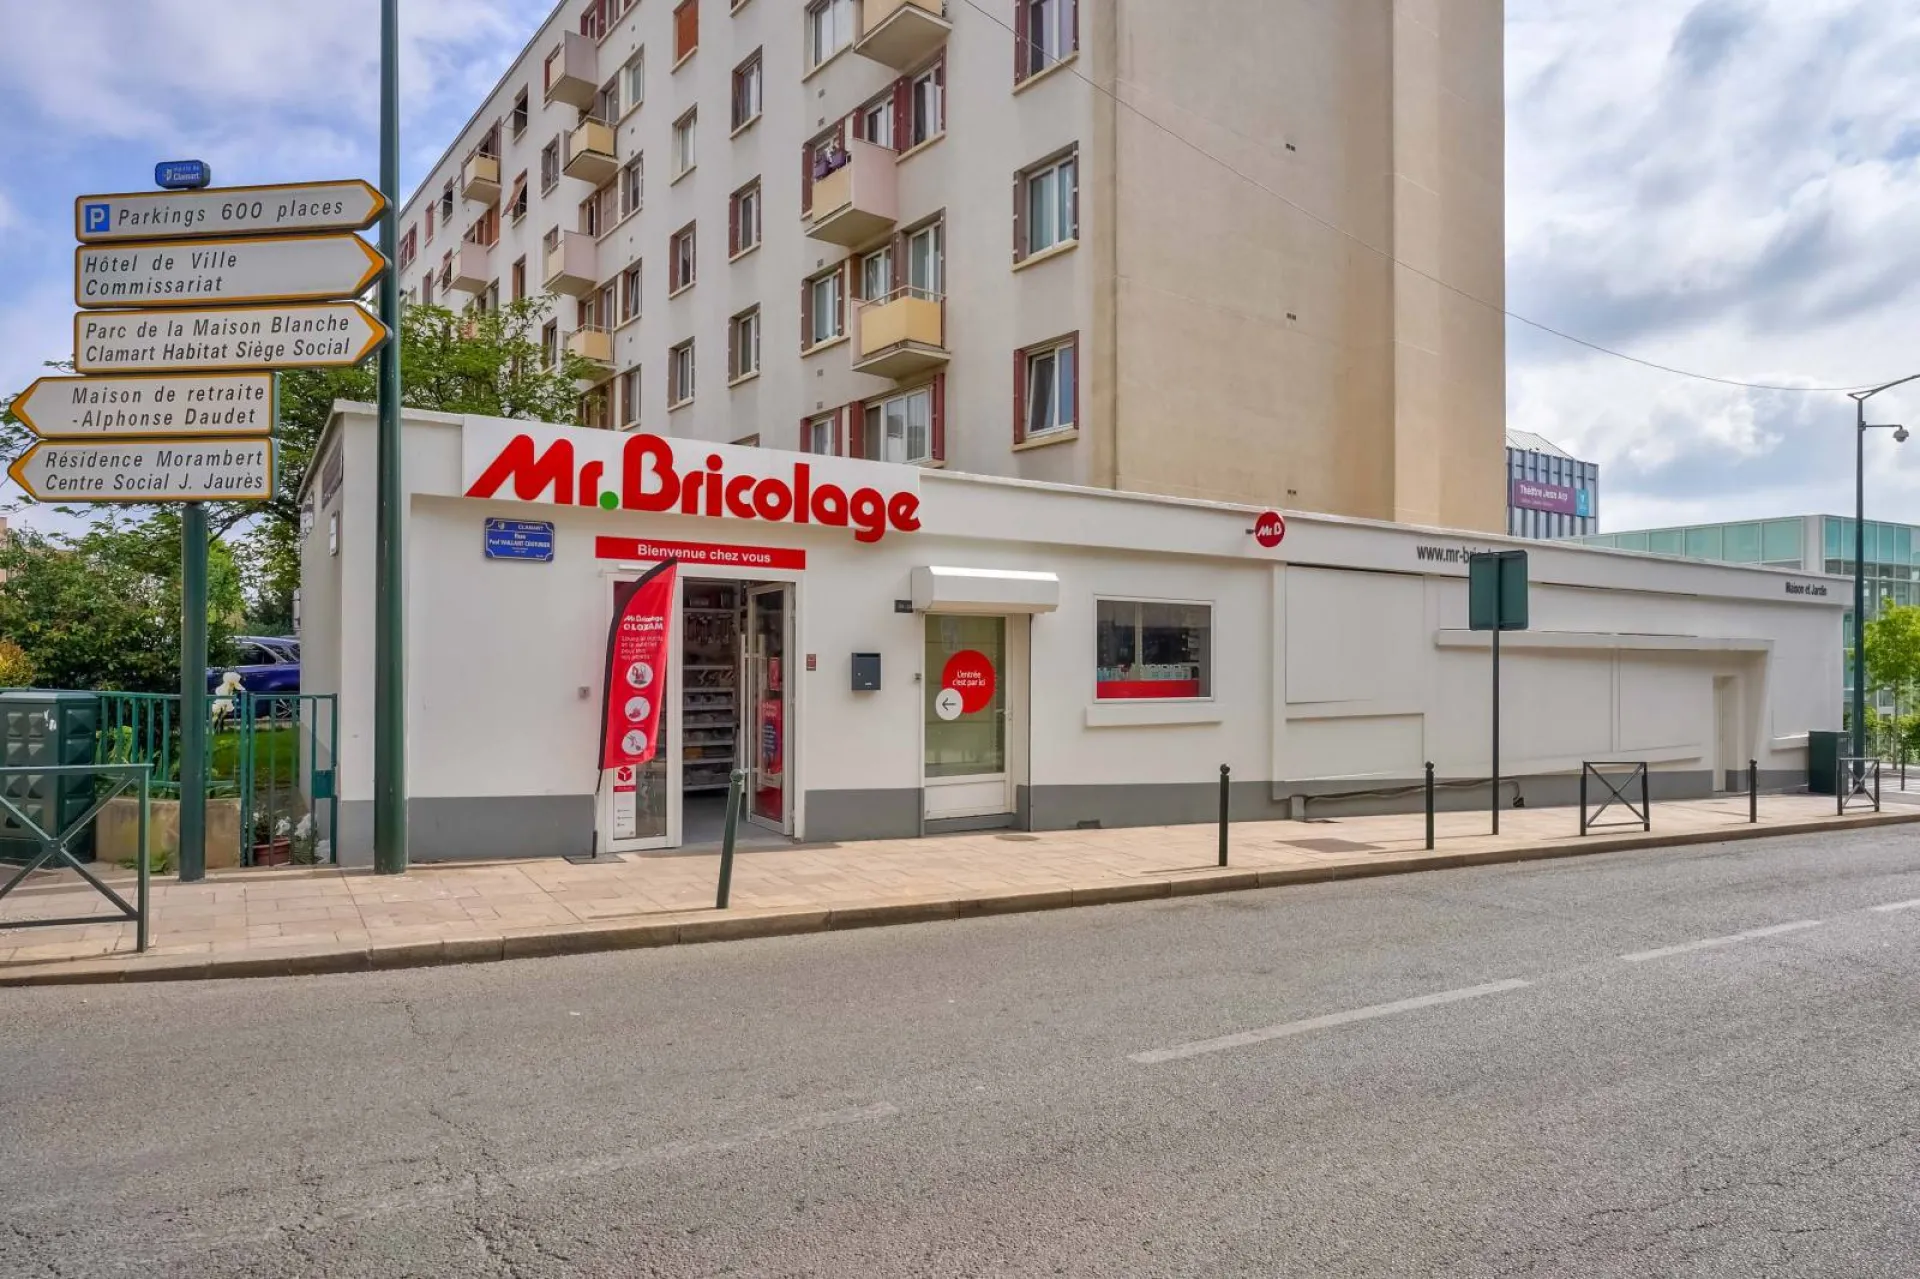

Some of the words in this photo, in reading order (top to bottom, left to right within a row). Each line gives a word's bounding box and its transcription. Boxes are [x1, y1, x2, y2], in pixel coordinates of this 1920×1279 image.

[90, 208, 105, 230] P
[118, 206, 206, 227] Parkings
[221, 202, 262, 220] 600
[276, 200, 343, 222] places
[85, 254, 137, 273] Hôtel
[152, 253, 174, 271] de
[192, 251, 237, 269] Ville
[86, 275, 223, 296] Commissariat
[86, 322, 127, 339] Parc
[137, 321, 157, 338] de
[167, 320, 183, 337] la
[193, 318, 260, 336] Maison
[271, 314, 349, 333] Blanche
[86, 345, 155, 362] Clamart
[163, 342, 228, 360] Habitat
[236, 340, 285, 362] Siège
[293, 337, 350, 356] Social
[72, 387, 142, 404] Maison
[154, 386, 175, 402] de
[187, 384, 264, 402] retraite
[185, 407, 256, 425] Daudet
[46, 451, 143, 468] Résidence
[156, 449, 263, 467] Morambert
[46, 474, 104, 490] Centre
[113, 473, 169, 490] Social
[178, 473, 192, 490] J.
[204, 472, 263, 489] Jaurès
[637, 544, 707, 559] Bienvenue
[709, 549, 739, 561] chez
[741, 553, 771, 563] vous
